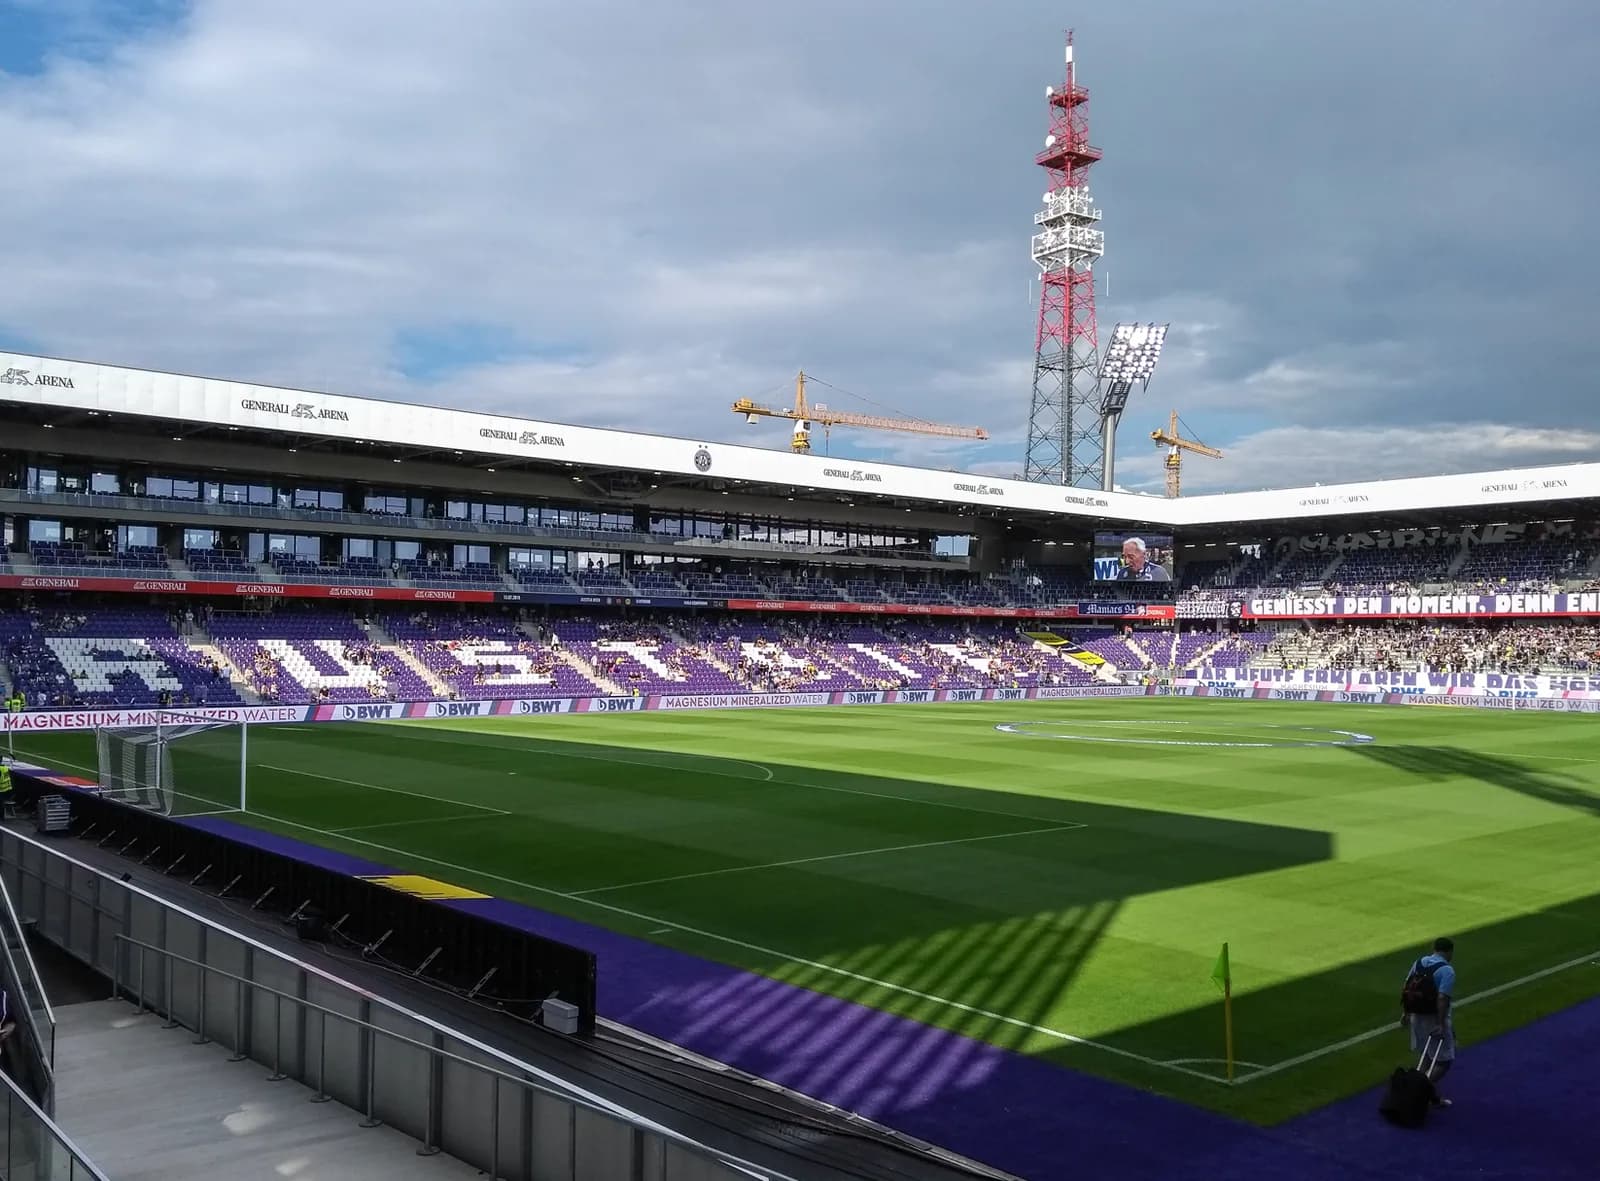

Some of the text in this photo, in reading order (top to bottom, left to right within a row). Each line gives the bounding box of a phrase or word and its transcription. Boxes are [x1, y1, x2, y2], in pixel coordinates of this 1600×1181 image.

[34, 374, 74, 389] ARENA
[241, 399, 349, 422] GENERALI ARENA
[479, 428, 565, 447] GENERALI ARENA
[823, 468, 849, 479] GENERALI
[953, 483, 976, 493] GENERALI
[35, 578, 79, 588] GENERALI
[146, 582, 187, 591] GENERALI
[247, 585, 284, 594] GENERALI
[339, 588, 374, 597] GENERALI
[424, 590, 455, 599] GENERALI
[1251, 598, 1336, 614] GENIESST
[1344, 598, 1381, 614] DEN
[1391, 595, 1486, 614] MOMENT,
[1496, 594, 1555, 613] DENN
[1567, 592, 1600, 613] EN
[1086, 604, 1123, 614] Maniacs
[1429, 672, 1475, 688] WIR
[909, 692, 928, 702] BWT
[959, 690, 976, 700] BWT
[1005, 689, 1022, 699] BWT
[1041, 688, 1080, 697] MAGNESIUM
[1223, 688, 1245, 698] BWT
[1285, 690, 1308, 699] BWT
[1350, 692, 1376, 702] BWT
[666, 694, 823, 708] MAGNESIUM MINERALIZED WATER
[857, 693, 877, 703] BWT
[1409, 695, 1479, 706] MAGNESIUM
[449, 702, 480, 716] BWT
[533, 700, 561, 713] BWT
[607, 699, 635, 711] BWT
[357, 705, 392, 719] BWT
[4, 714, 120, 729] MAGNESIUM
[244, 708, 297, 722] WATER
